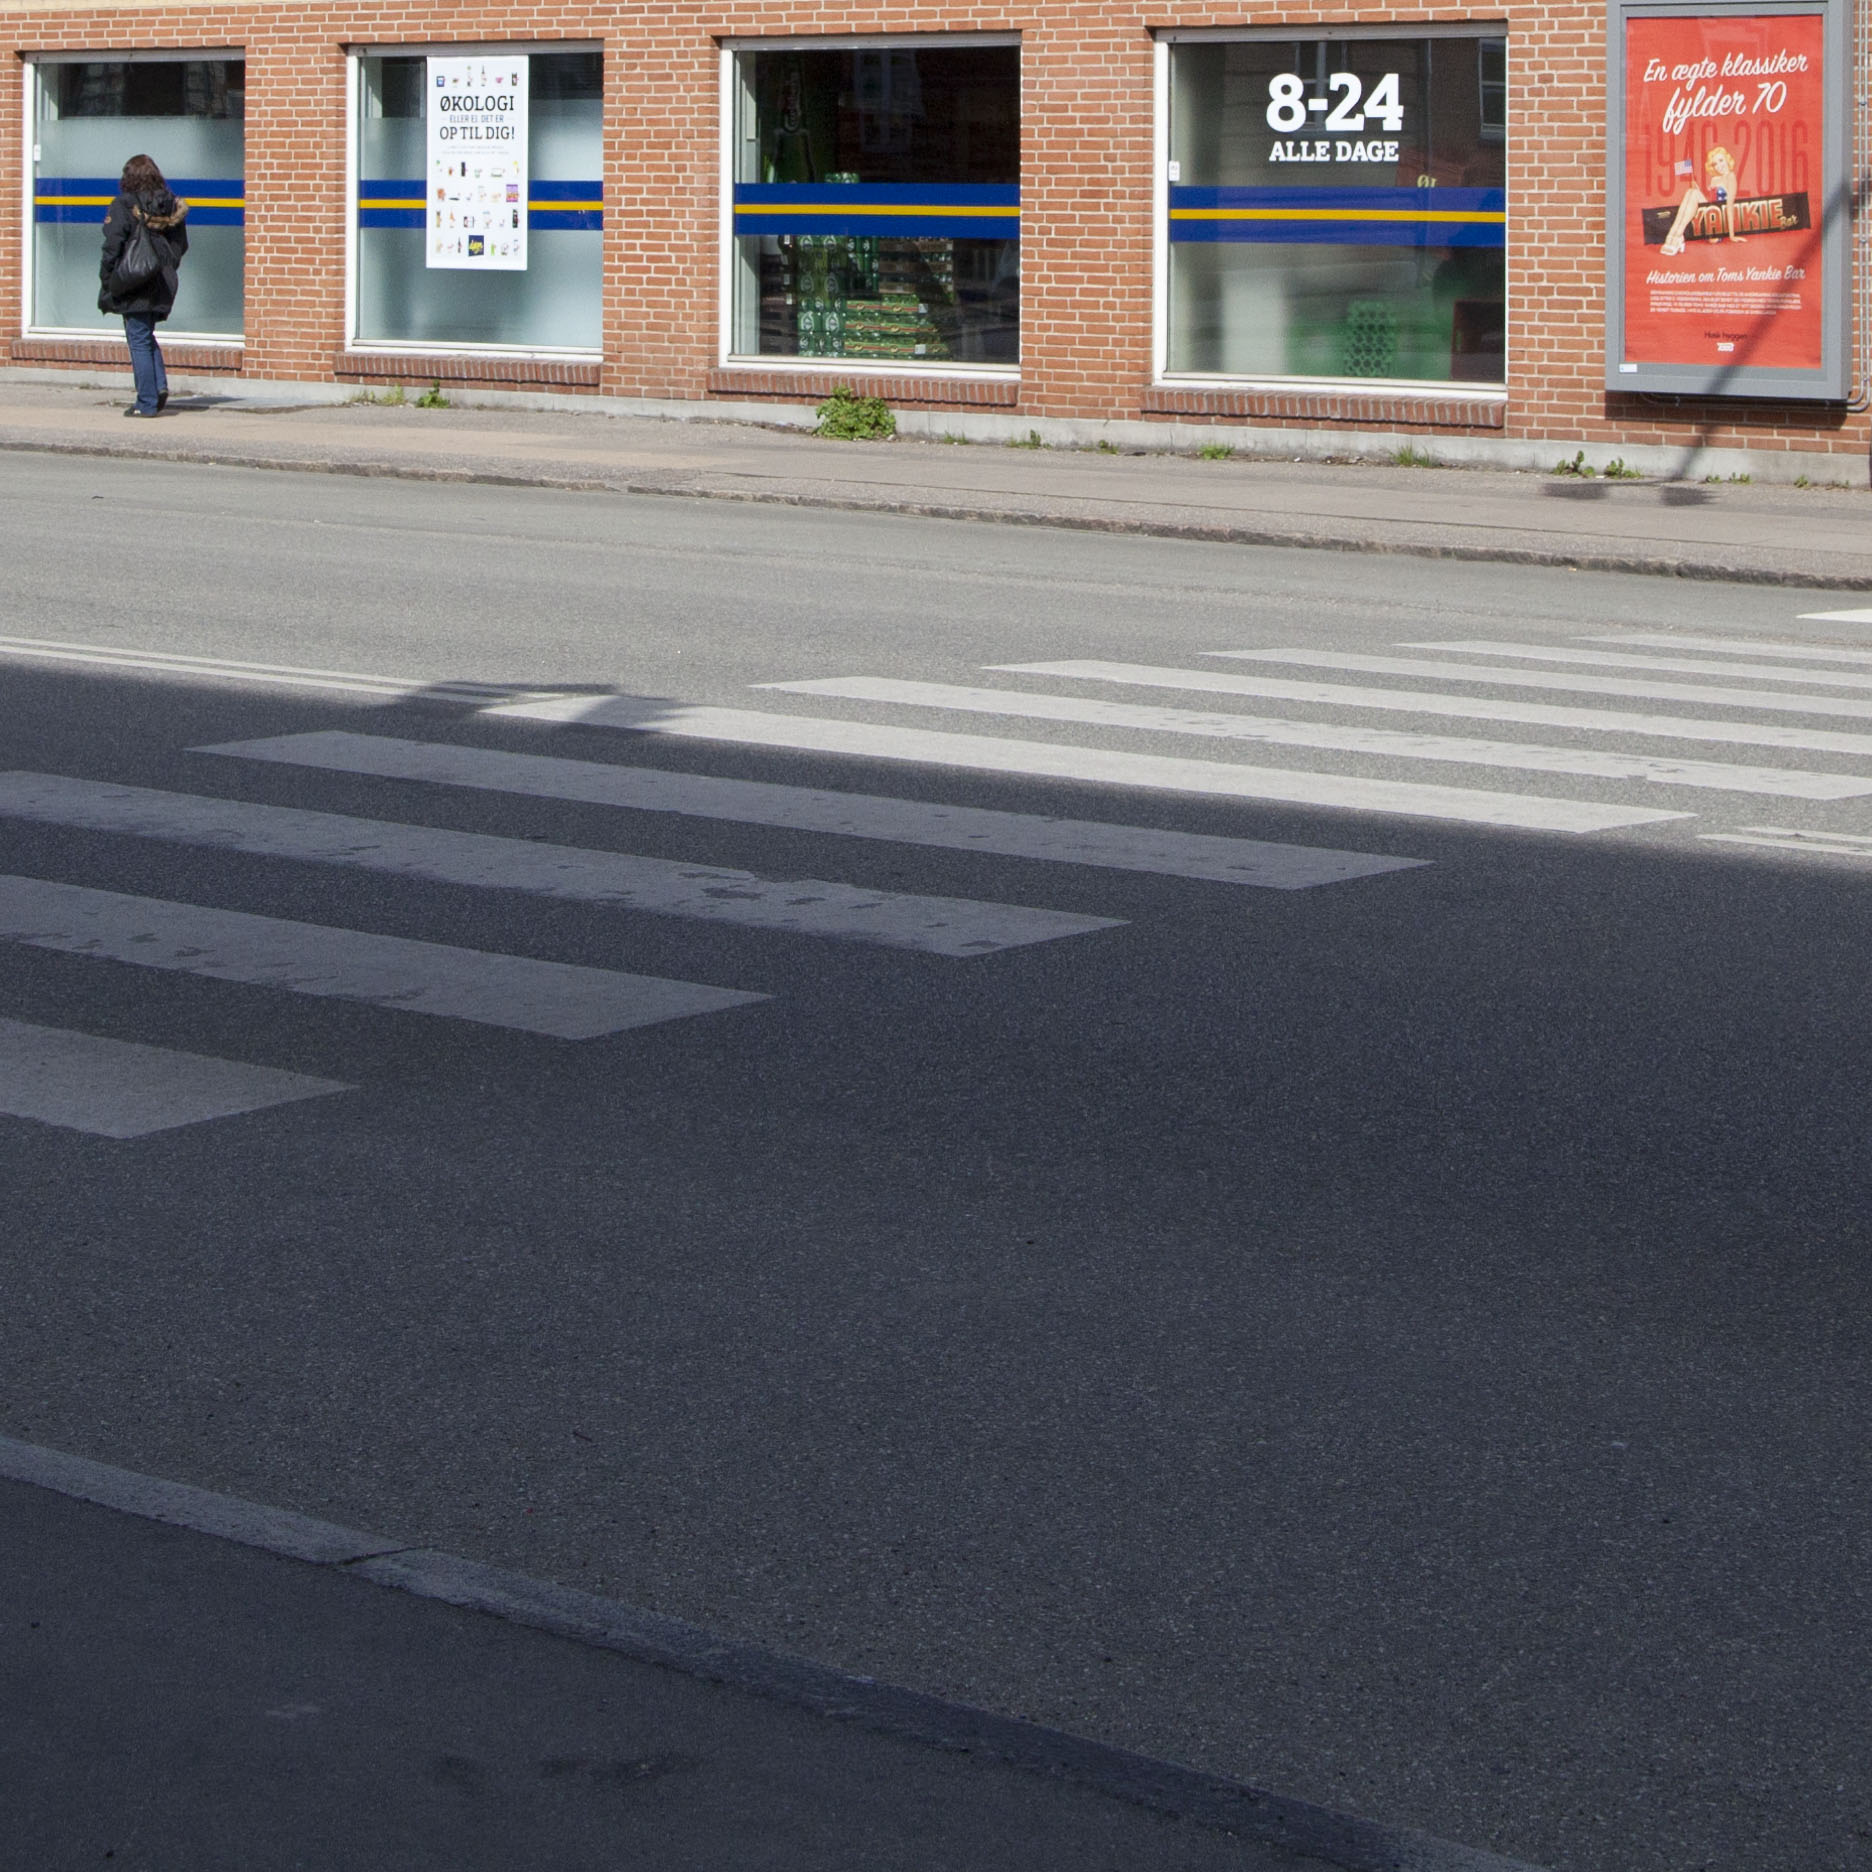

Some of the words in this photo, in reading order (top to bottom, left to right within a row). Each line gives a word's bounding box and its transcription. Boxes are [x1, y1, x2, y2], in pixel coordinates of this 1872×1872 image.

[1643, 58, 1668, 82] En
[1671, 56, 1718, 91] ægte
[1720, 48, 1809, 77] klassiker
[440, 95, 515, 112] ØKOLOGI
[1266, 72, 1405, 133] 8-24
[1662, 84, 1747, 135] fylder
[1752, 80, 1788, 114] 70
[439, 126, 458, 140] OP
[459, 126, 483, 140] TIL
[485, 126, 515, 140] DIG!
[1269, 141, 1330, 162] ALLE
[1335, 141, 1399, 162] DAGE
[1733, 119, 1809, 197] 2016
[1646, 270, 1696, 285] Historien
[1698, 274, 1715, 283] om
[1716, 266, 1744, 283] Toms
[1745, 265, 1783, 282] Yankie
[1784, 264, 1806, 281] Bar
